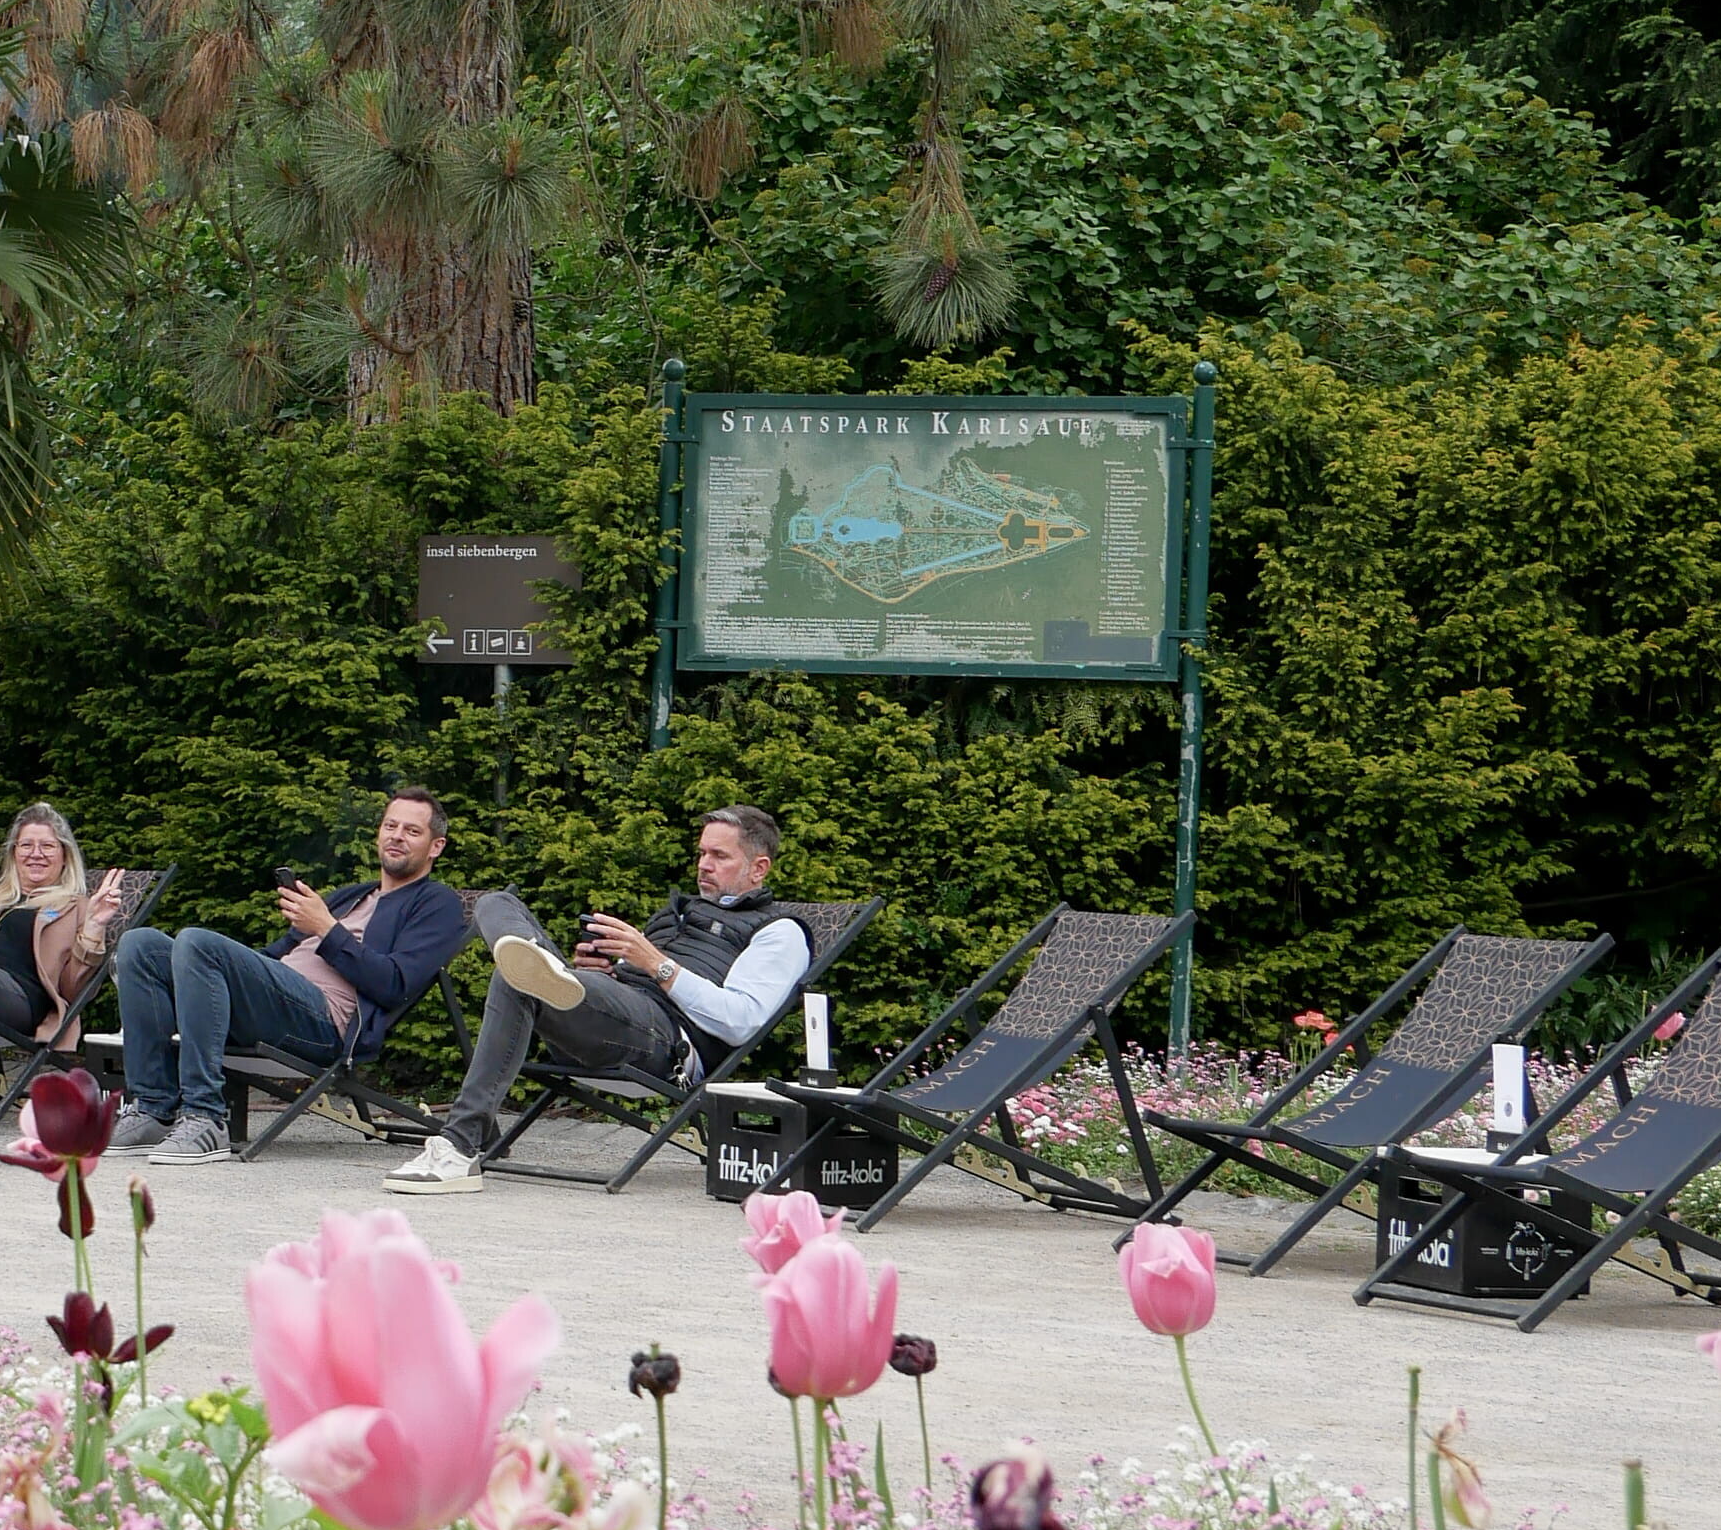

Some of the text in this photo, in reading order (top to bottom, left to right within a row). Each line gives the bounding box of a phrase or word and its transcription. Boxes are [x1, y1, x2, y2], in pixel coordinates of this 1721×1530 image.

[721, 409, 911, 435] STAATSPARK
[931, 411, 1094, 437] KARLSAUE
[426, 544, 538, 560] insel siebenbergen
[718, 1143, 791, 1189] fritz-kol
[821, 1159, 884, 1186] fritz-kola
